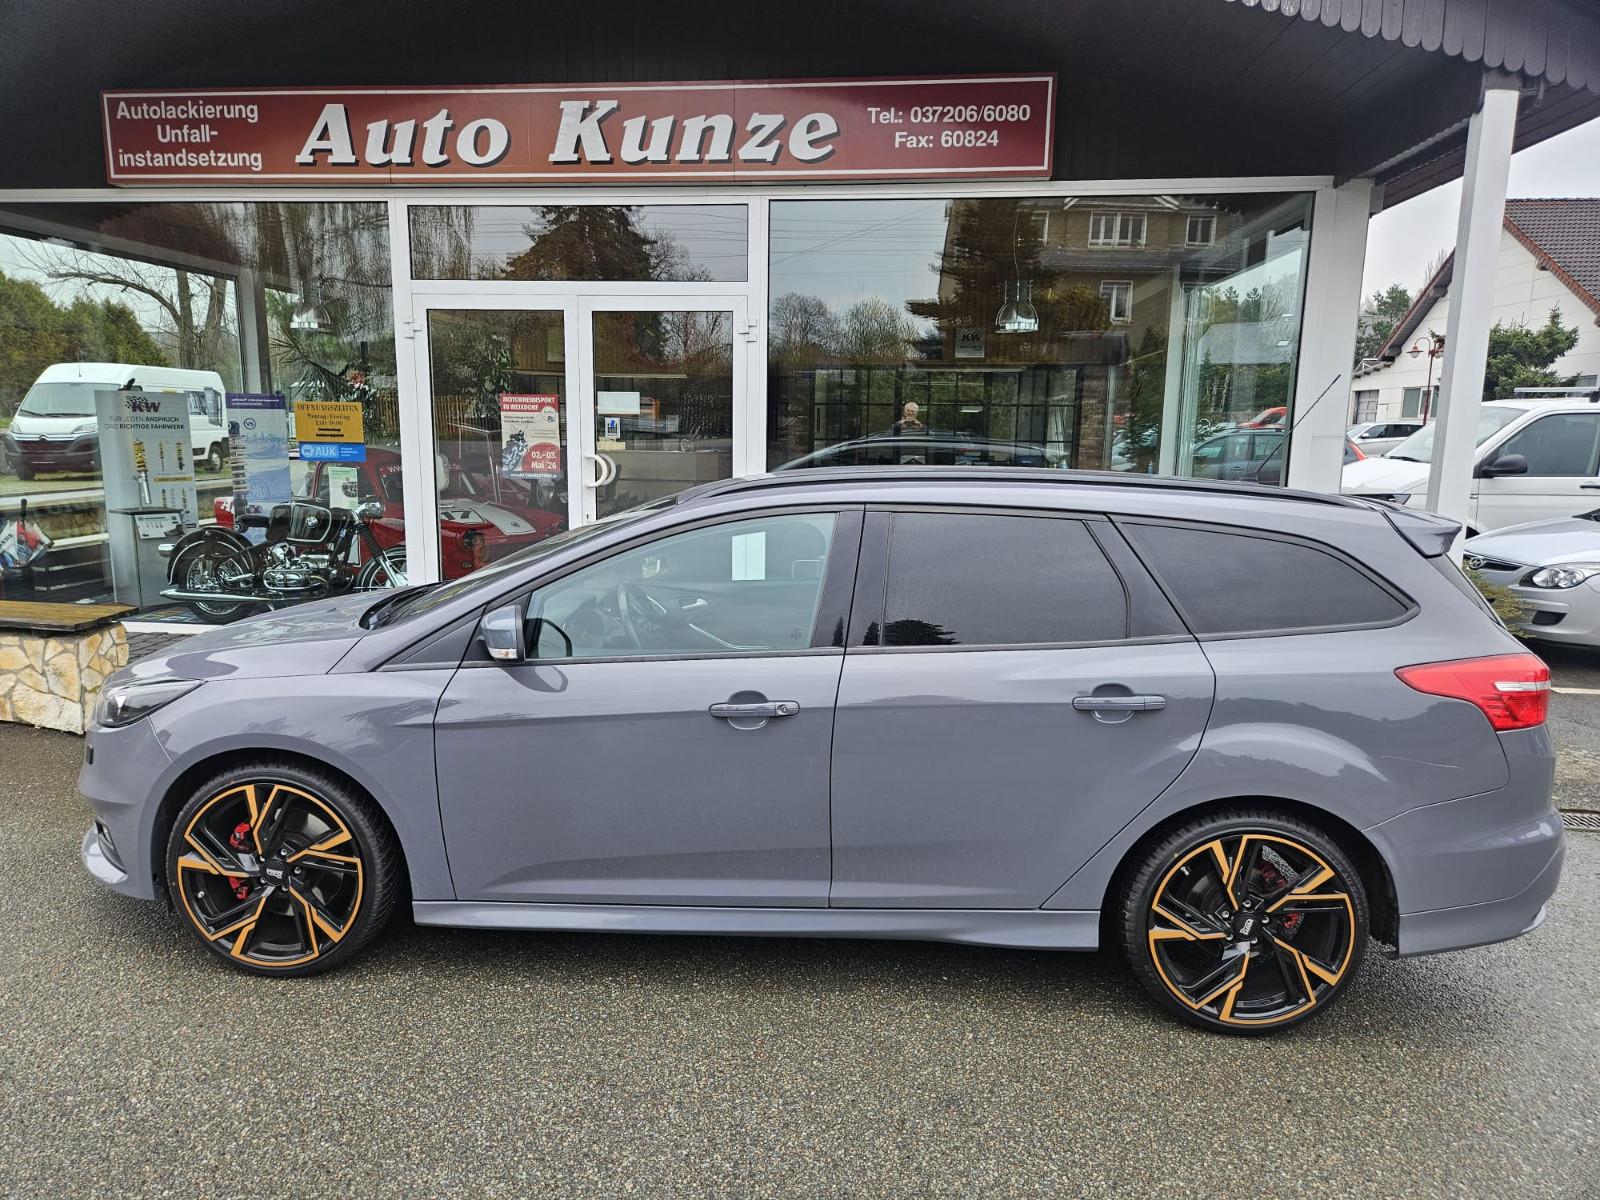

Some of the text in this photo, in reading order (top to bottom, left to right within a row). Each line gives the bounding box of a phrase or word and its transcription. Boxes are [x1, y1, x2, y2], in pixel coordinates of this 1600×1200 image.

[116, 100, 259, 123] Autolackierung
[867, 104, 1031, 124] Tel.: 037206/6080
[157, 124, 218, 143] Unfall-
[295, 100, 838, 165] Auto Kunze
[895, 130, 999, 148] Fax: 60824
[118, 148, 262, 172] instandsetzung
[502, 396, 556, 404] MOTORRENNSPORT
[315, 446, 337, 457] AUK
[531, 461, 545, 470] Mai
